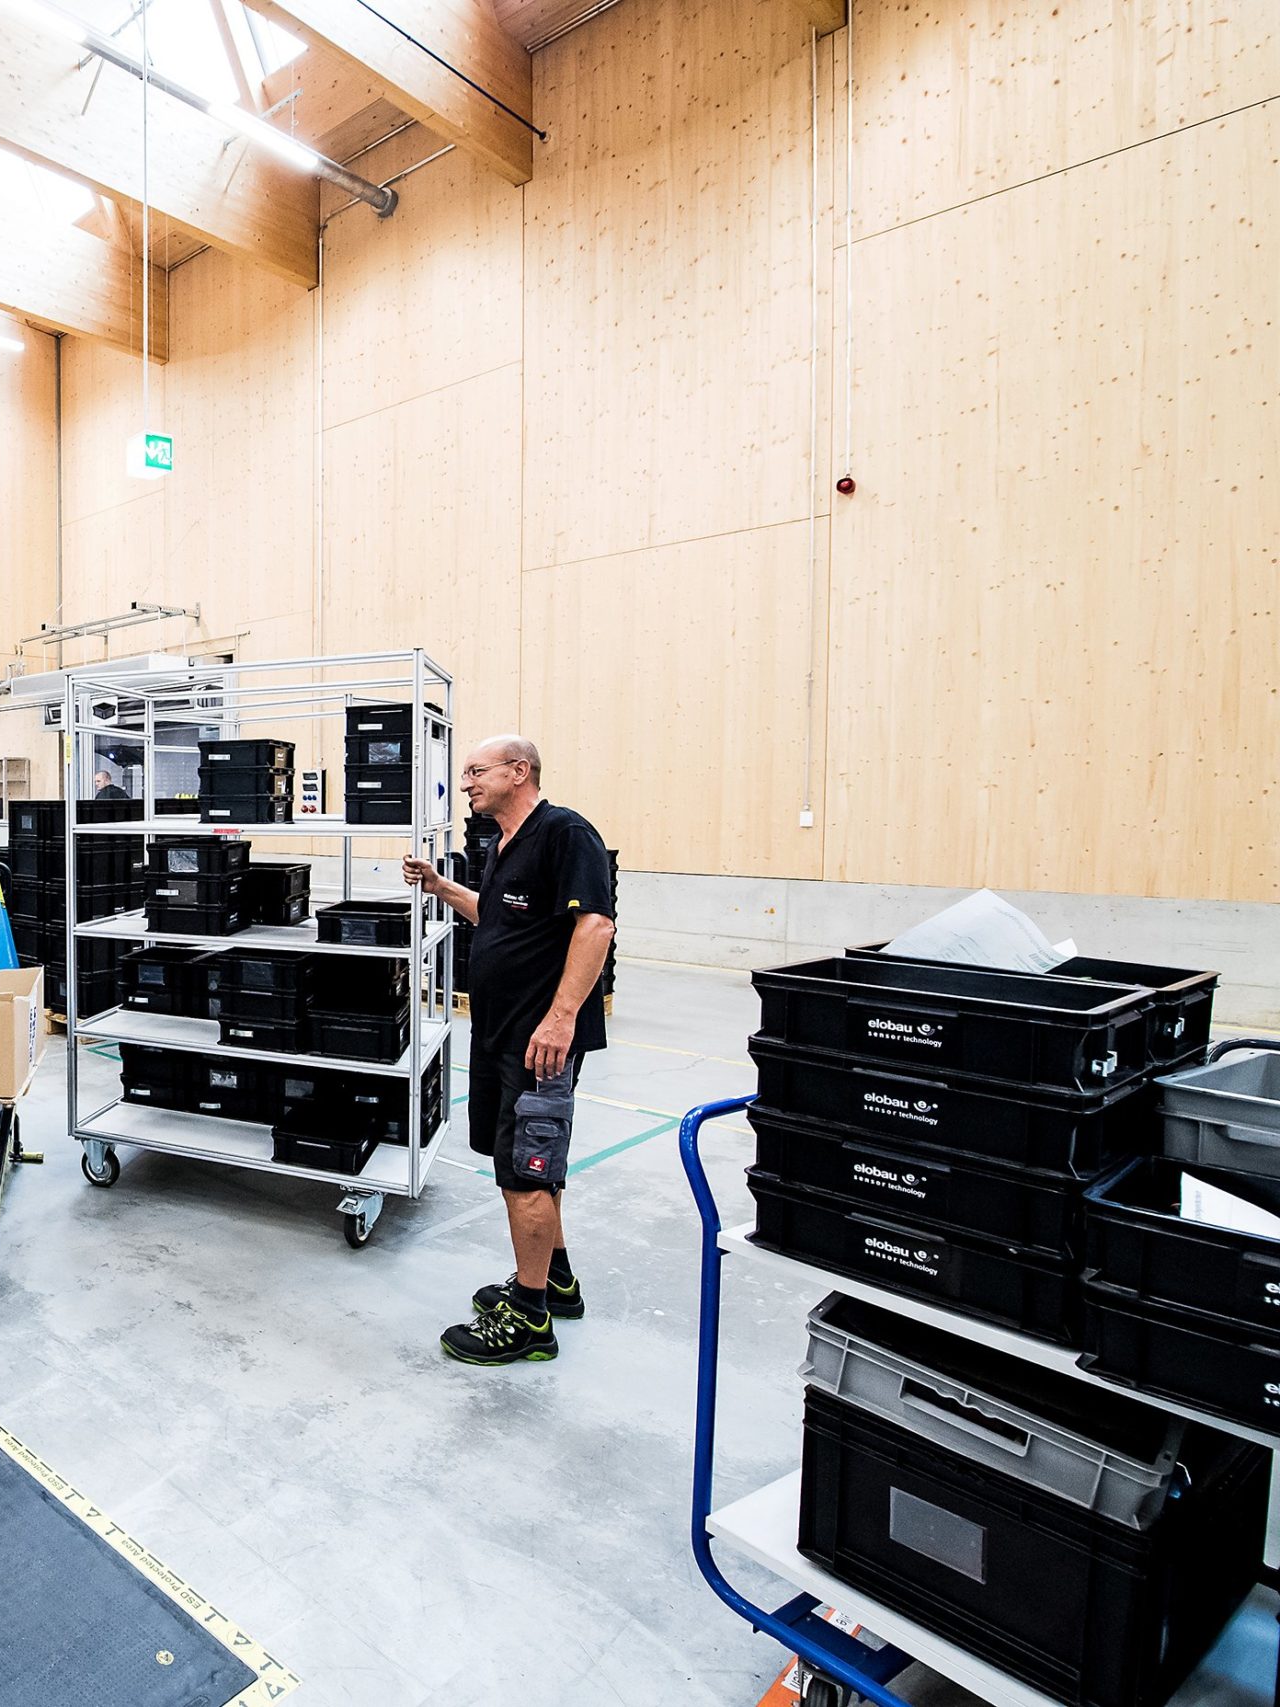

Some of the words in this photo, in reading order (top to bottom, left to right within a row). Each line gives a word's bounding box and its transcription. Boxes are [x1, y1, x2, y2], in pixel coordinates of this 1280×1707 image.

[868, 1018, 912, 1033] elobau
[868, 1030, 901, 1040] sensor
[903, 1035, 942, 1048] technology
[864, 1092, 909, 1109] elobau
[864, 1104, 897, 1116] sensor
[898, 1111, 938, 1126] technology
[854, 1163, 898, 1181] elobau
[854, 1174, 886, 1187] sensor
[888, 1182, 926, 1199] technology
[864, 1238, 910, 1257] elobau
[864, 1248, 898, 1262] sensor
[899, 1258, 938, 1276] technology
[4, 1438, 20, 1451] Area
[18, 1450, 48, 1478] Protected
[48, 1477, 64, 1490] ESD
[121, 1540, 140, 1556] Area
[140, 1556, 181, 1592] Protected
[180, 1591, 202, 1610] ESD
